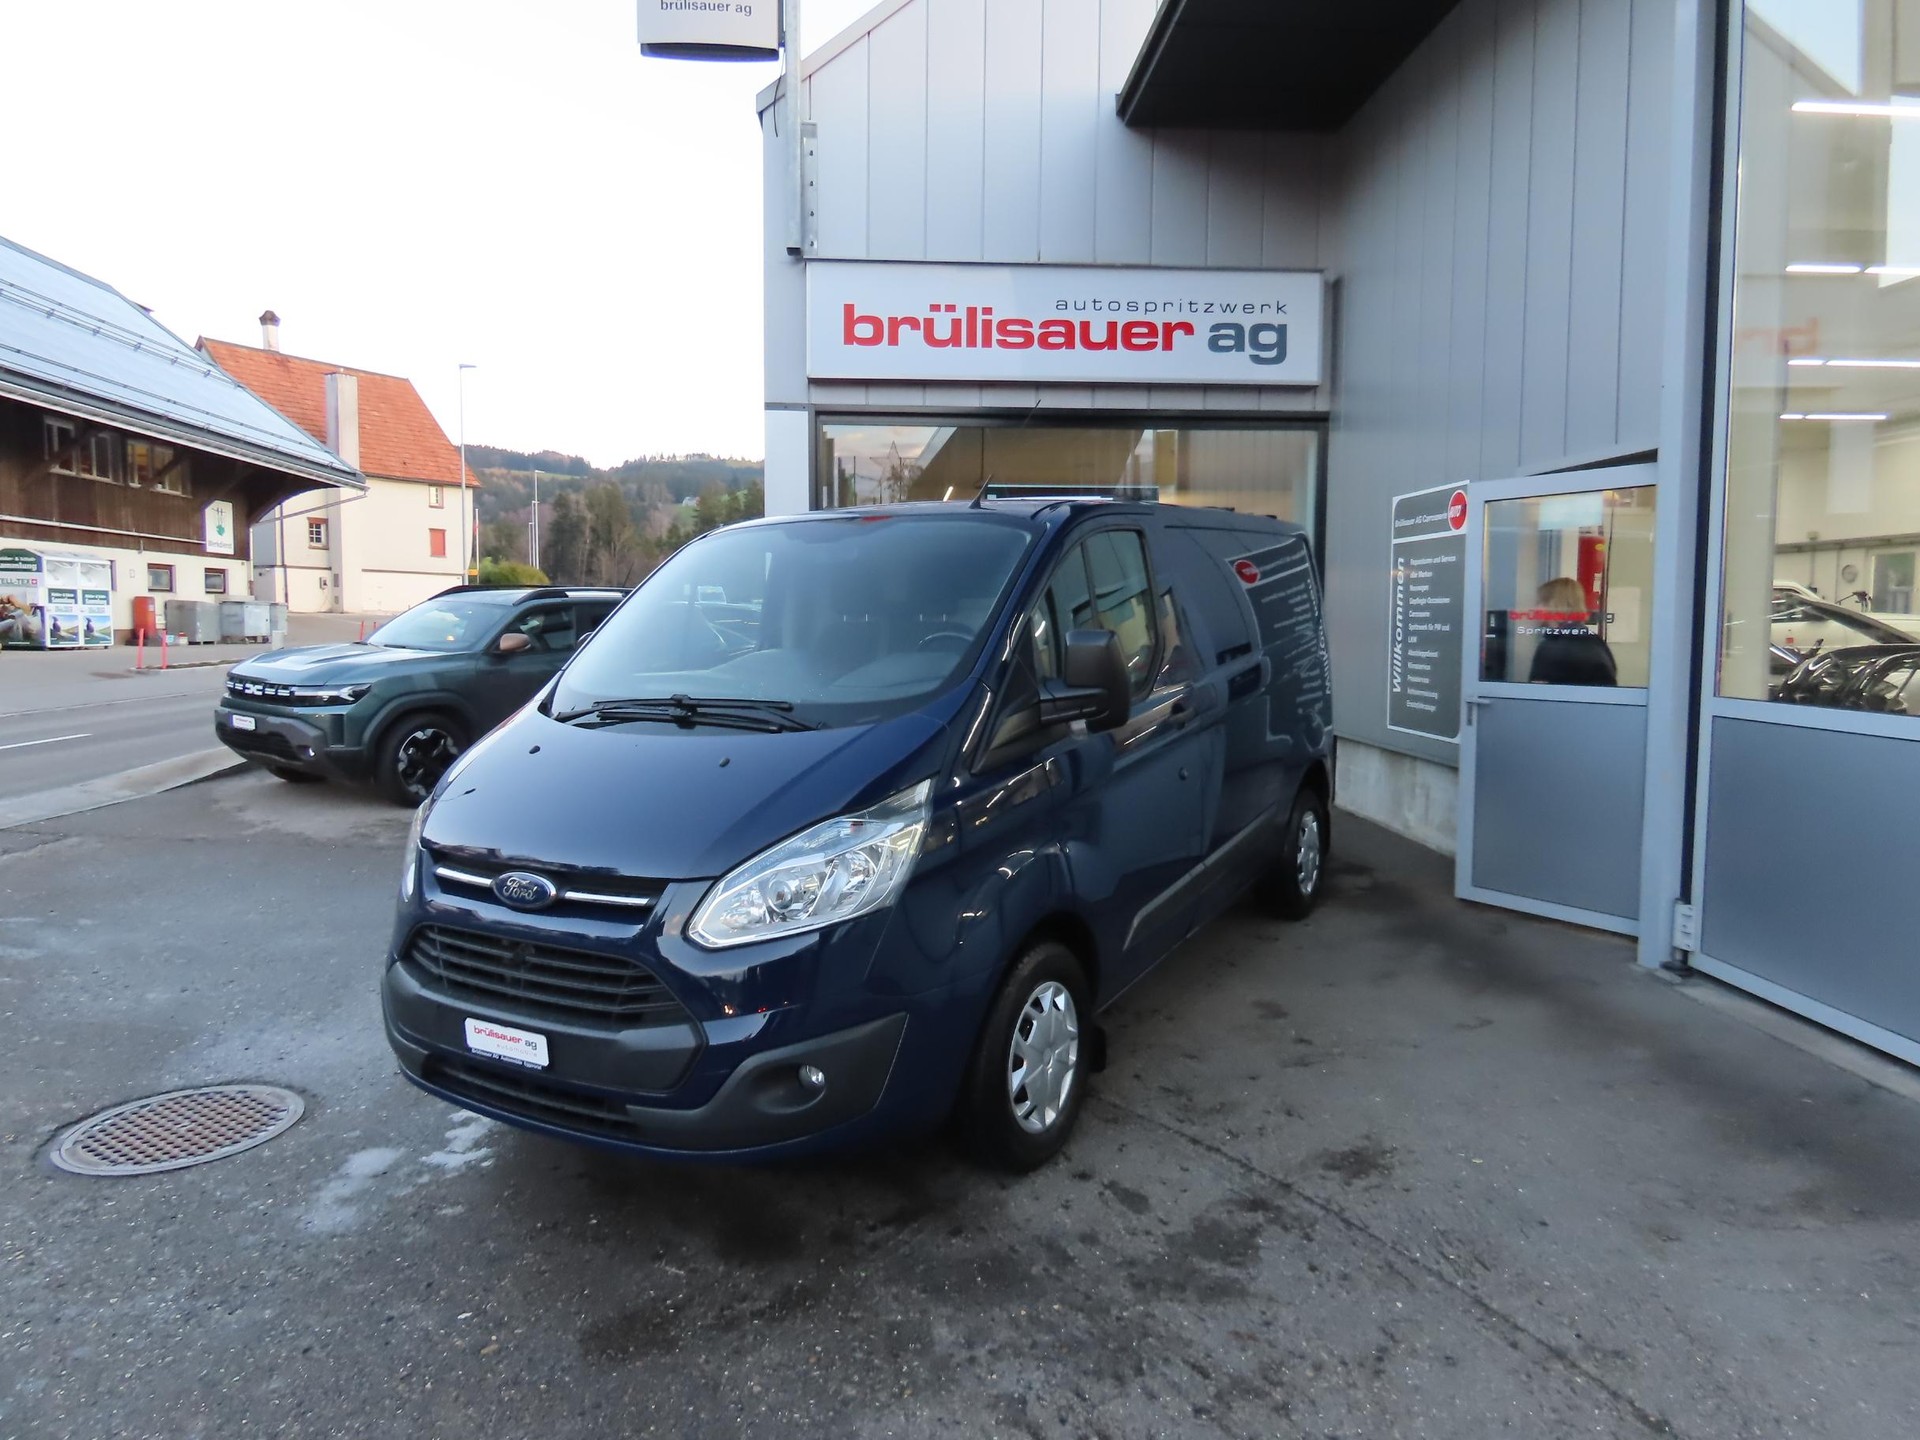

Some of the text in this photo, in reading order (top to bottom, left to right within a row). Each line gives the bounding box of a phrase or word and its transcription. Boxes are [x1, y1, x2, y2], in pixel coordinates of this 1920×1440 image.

[660, 0, 752, 17] brülisauer ag
[1056, 298, 1288, 316] autospritzwerk
[843, 303, 1288, 365] brülisauer ag
[1393, 557, 1405, 693] Willkommen
[1516, 625, 1597, 636] Spritzwerk
[503, 876, 538, 900] Ford
[474, 1025, 538, 1050] brülisauer ag
